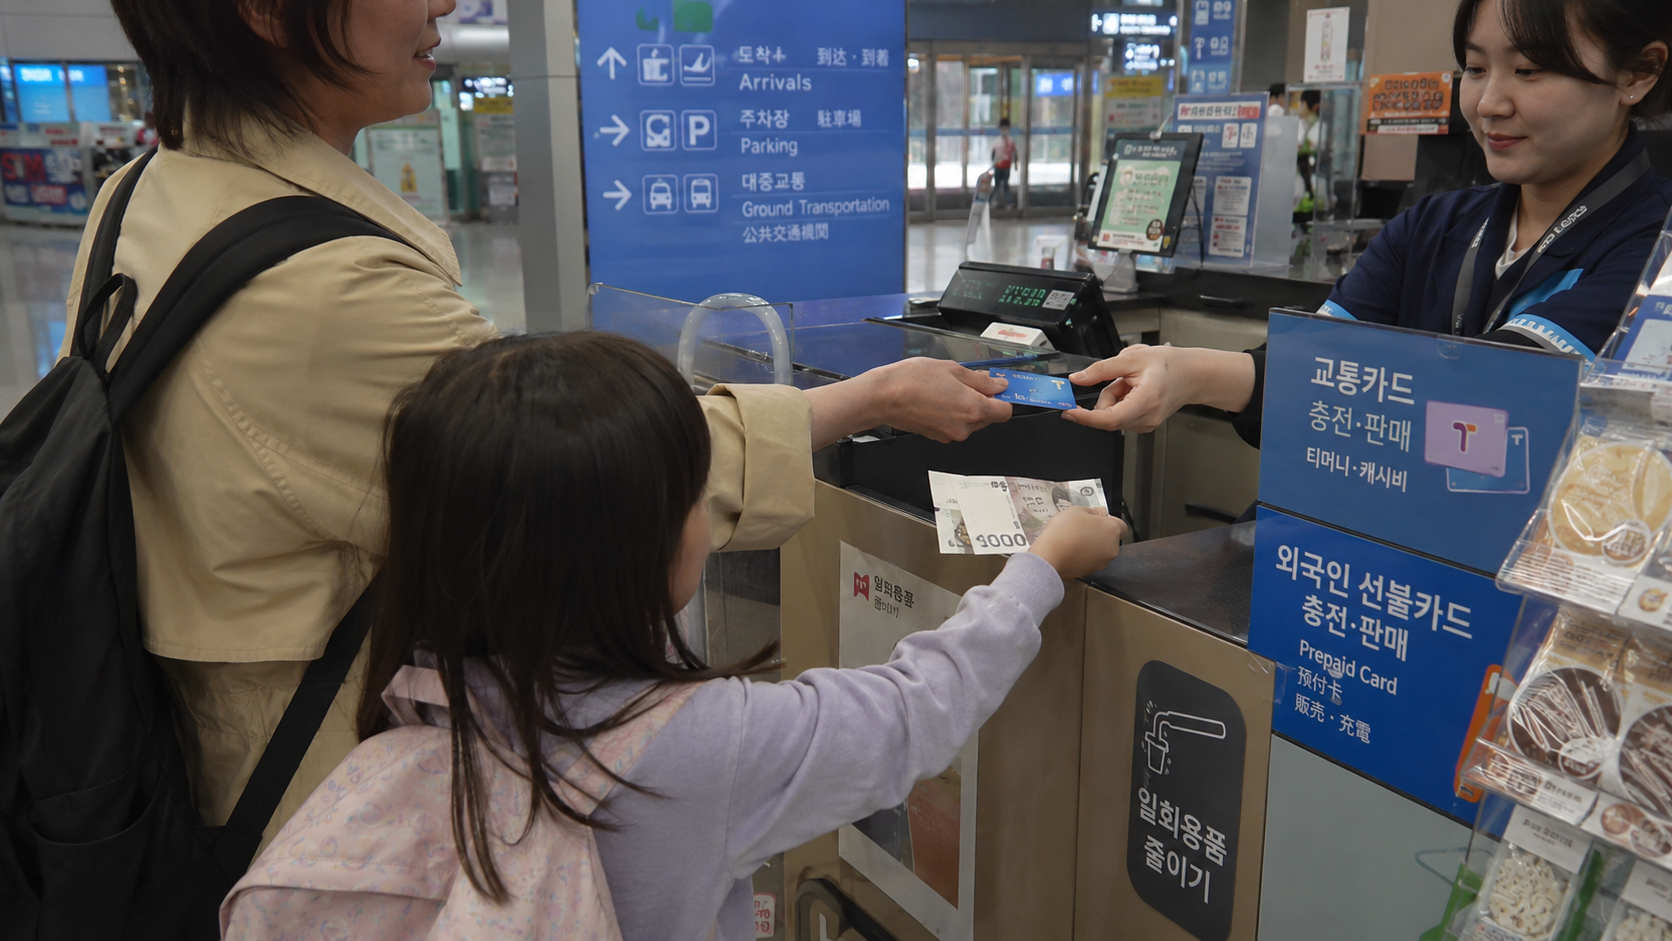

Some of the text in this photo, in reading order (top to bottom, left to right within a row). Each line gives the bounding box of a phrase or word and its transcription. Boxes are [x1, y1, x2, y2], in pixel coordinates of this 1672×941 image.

[738, 73, 812, 91] Arrivals
[740, 109, 790, 129] 주차장
[817, 109, 862, 128] 駐車場
[741, 138, 798, 157] Parking
[742, 171, 806, 191] 대중교통
[742, 196, 890, 218] Ground Transportation
[742, 222, 829, 244] 公共交通機関
[1310, 356, 1415, 405] 교통카드
[1308, 400, 1411, 453] 충전·판매
[1306, 446, 1408, 493] 티머니·캐시비
[1275, 544, 1473, 639] 외국인 선불카드
[1301, 594, 1409, 662] 충전·판매
[1297, 665, 1343, 702] 预付卡
[1299, 639, 1398, 695] Prepaid Card
[1138, 787, 1227, 867] 일회용품
[1144, 834, 1211, 904] 줄이기
